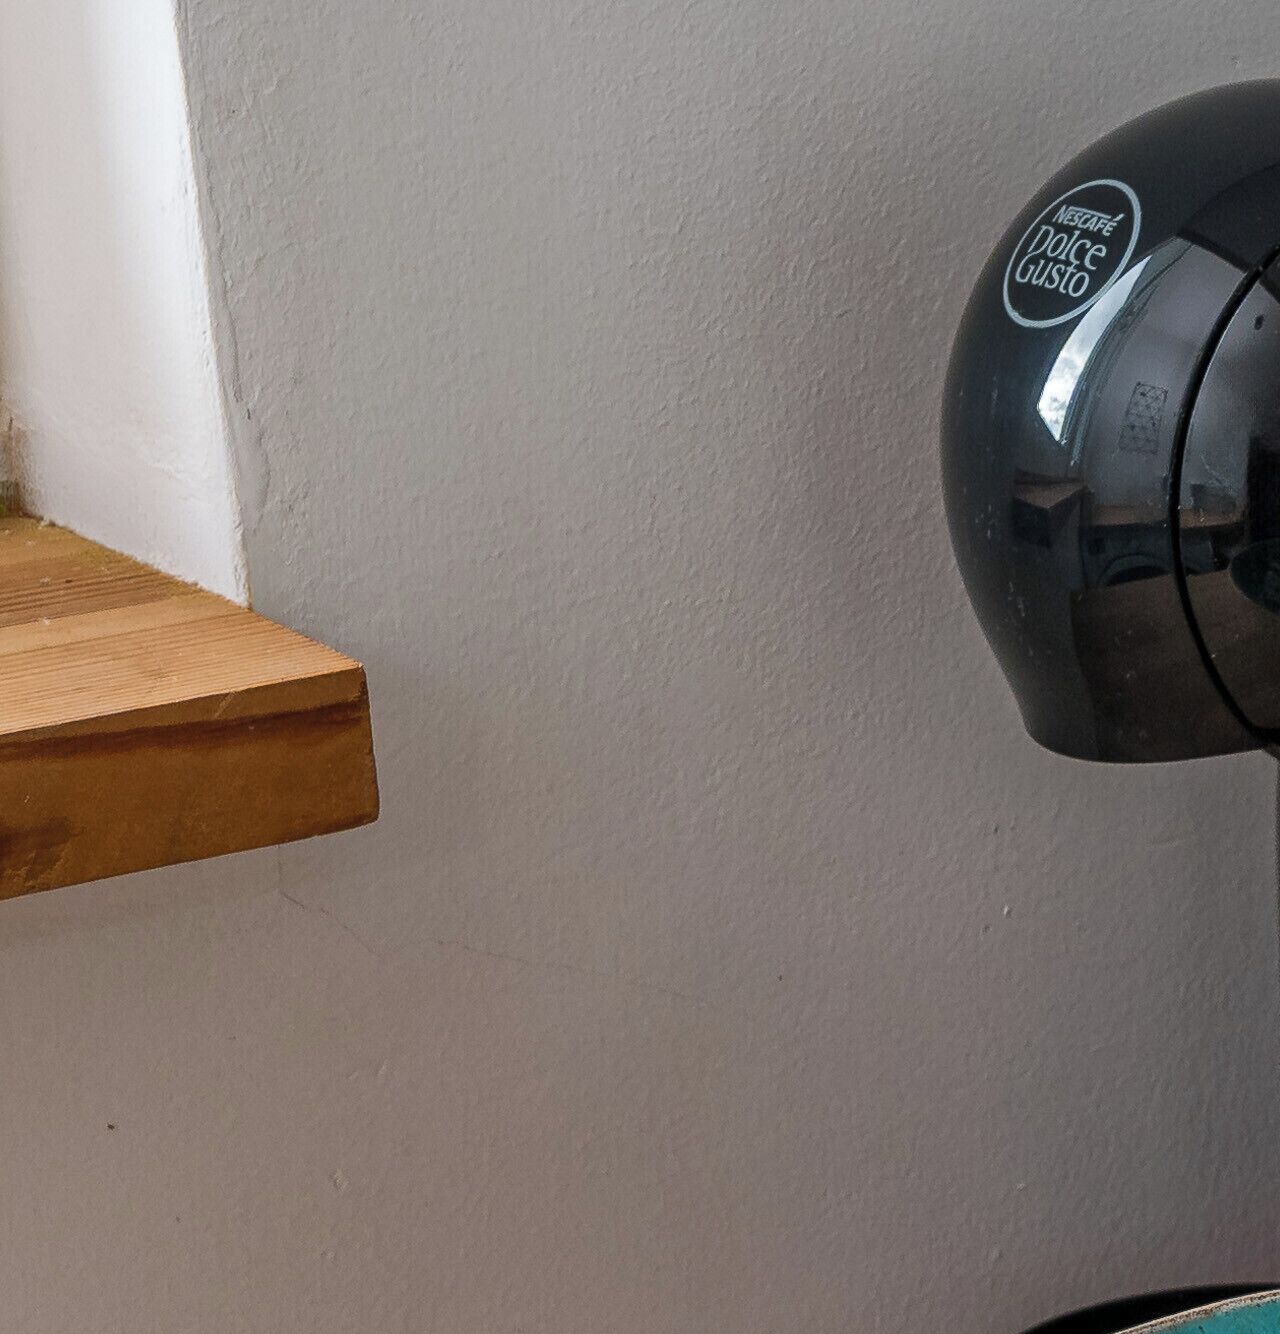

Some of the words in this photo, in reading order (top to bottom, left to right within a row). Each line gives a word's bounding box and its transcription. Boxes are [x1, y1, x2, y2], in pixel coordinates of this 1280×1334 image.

[1052, 204, 1125, 237] NESCAFÉ
[1027, 224, 1107, 270] Dolce
[1015, 254, 1090, 298] Gusto
